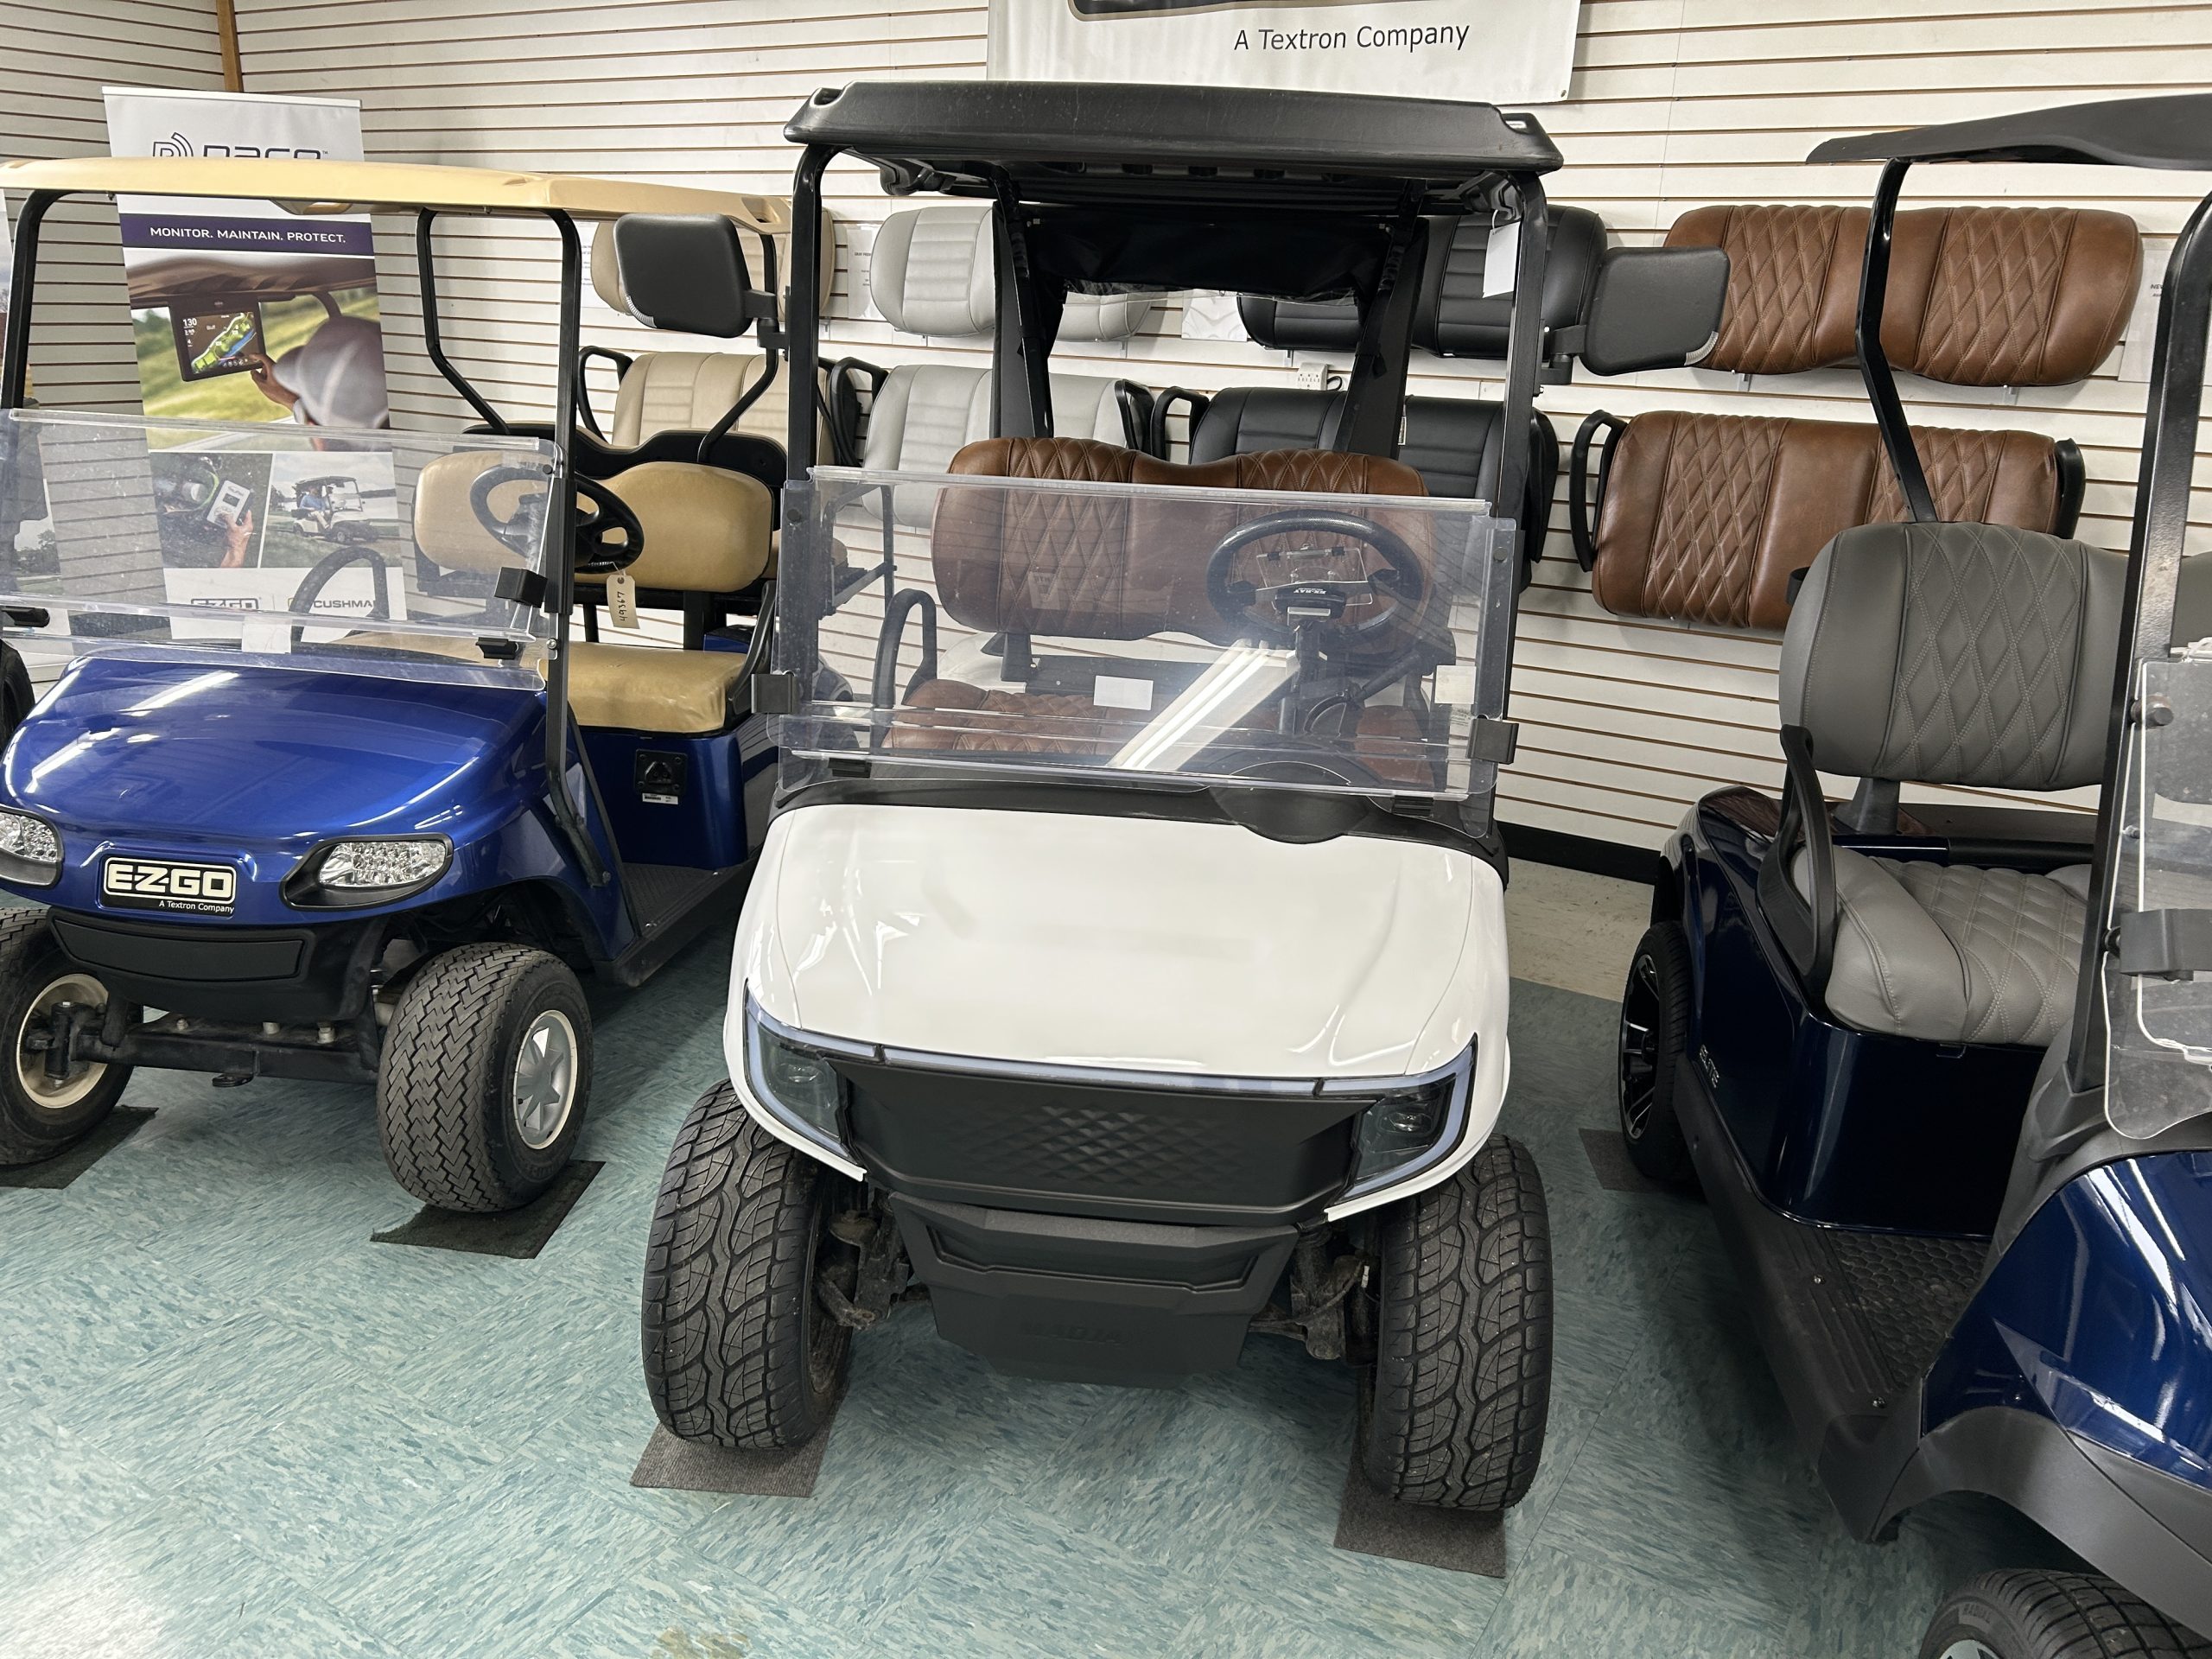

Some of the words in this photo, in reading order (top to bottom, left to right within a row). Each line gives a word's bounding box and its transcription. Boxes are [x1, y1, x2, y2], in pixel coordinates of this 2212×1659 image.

[1234, 29, 1249, 50] A
[1258, 29, 1346, 50] Textron
[1357, 25, 1470, 53] Company
[149, 226, 213, 238] MONITOR.
[217, 229, 283, 241] MAINTAIN.
[287, 232, 346, 244] PROTECT.
[182, 317, 198, 327] 130
[313, 600, 377, 608] CUSHMA
[167, 900, 196, 910] Textron
[198, 903, 235, 914] Company
